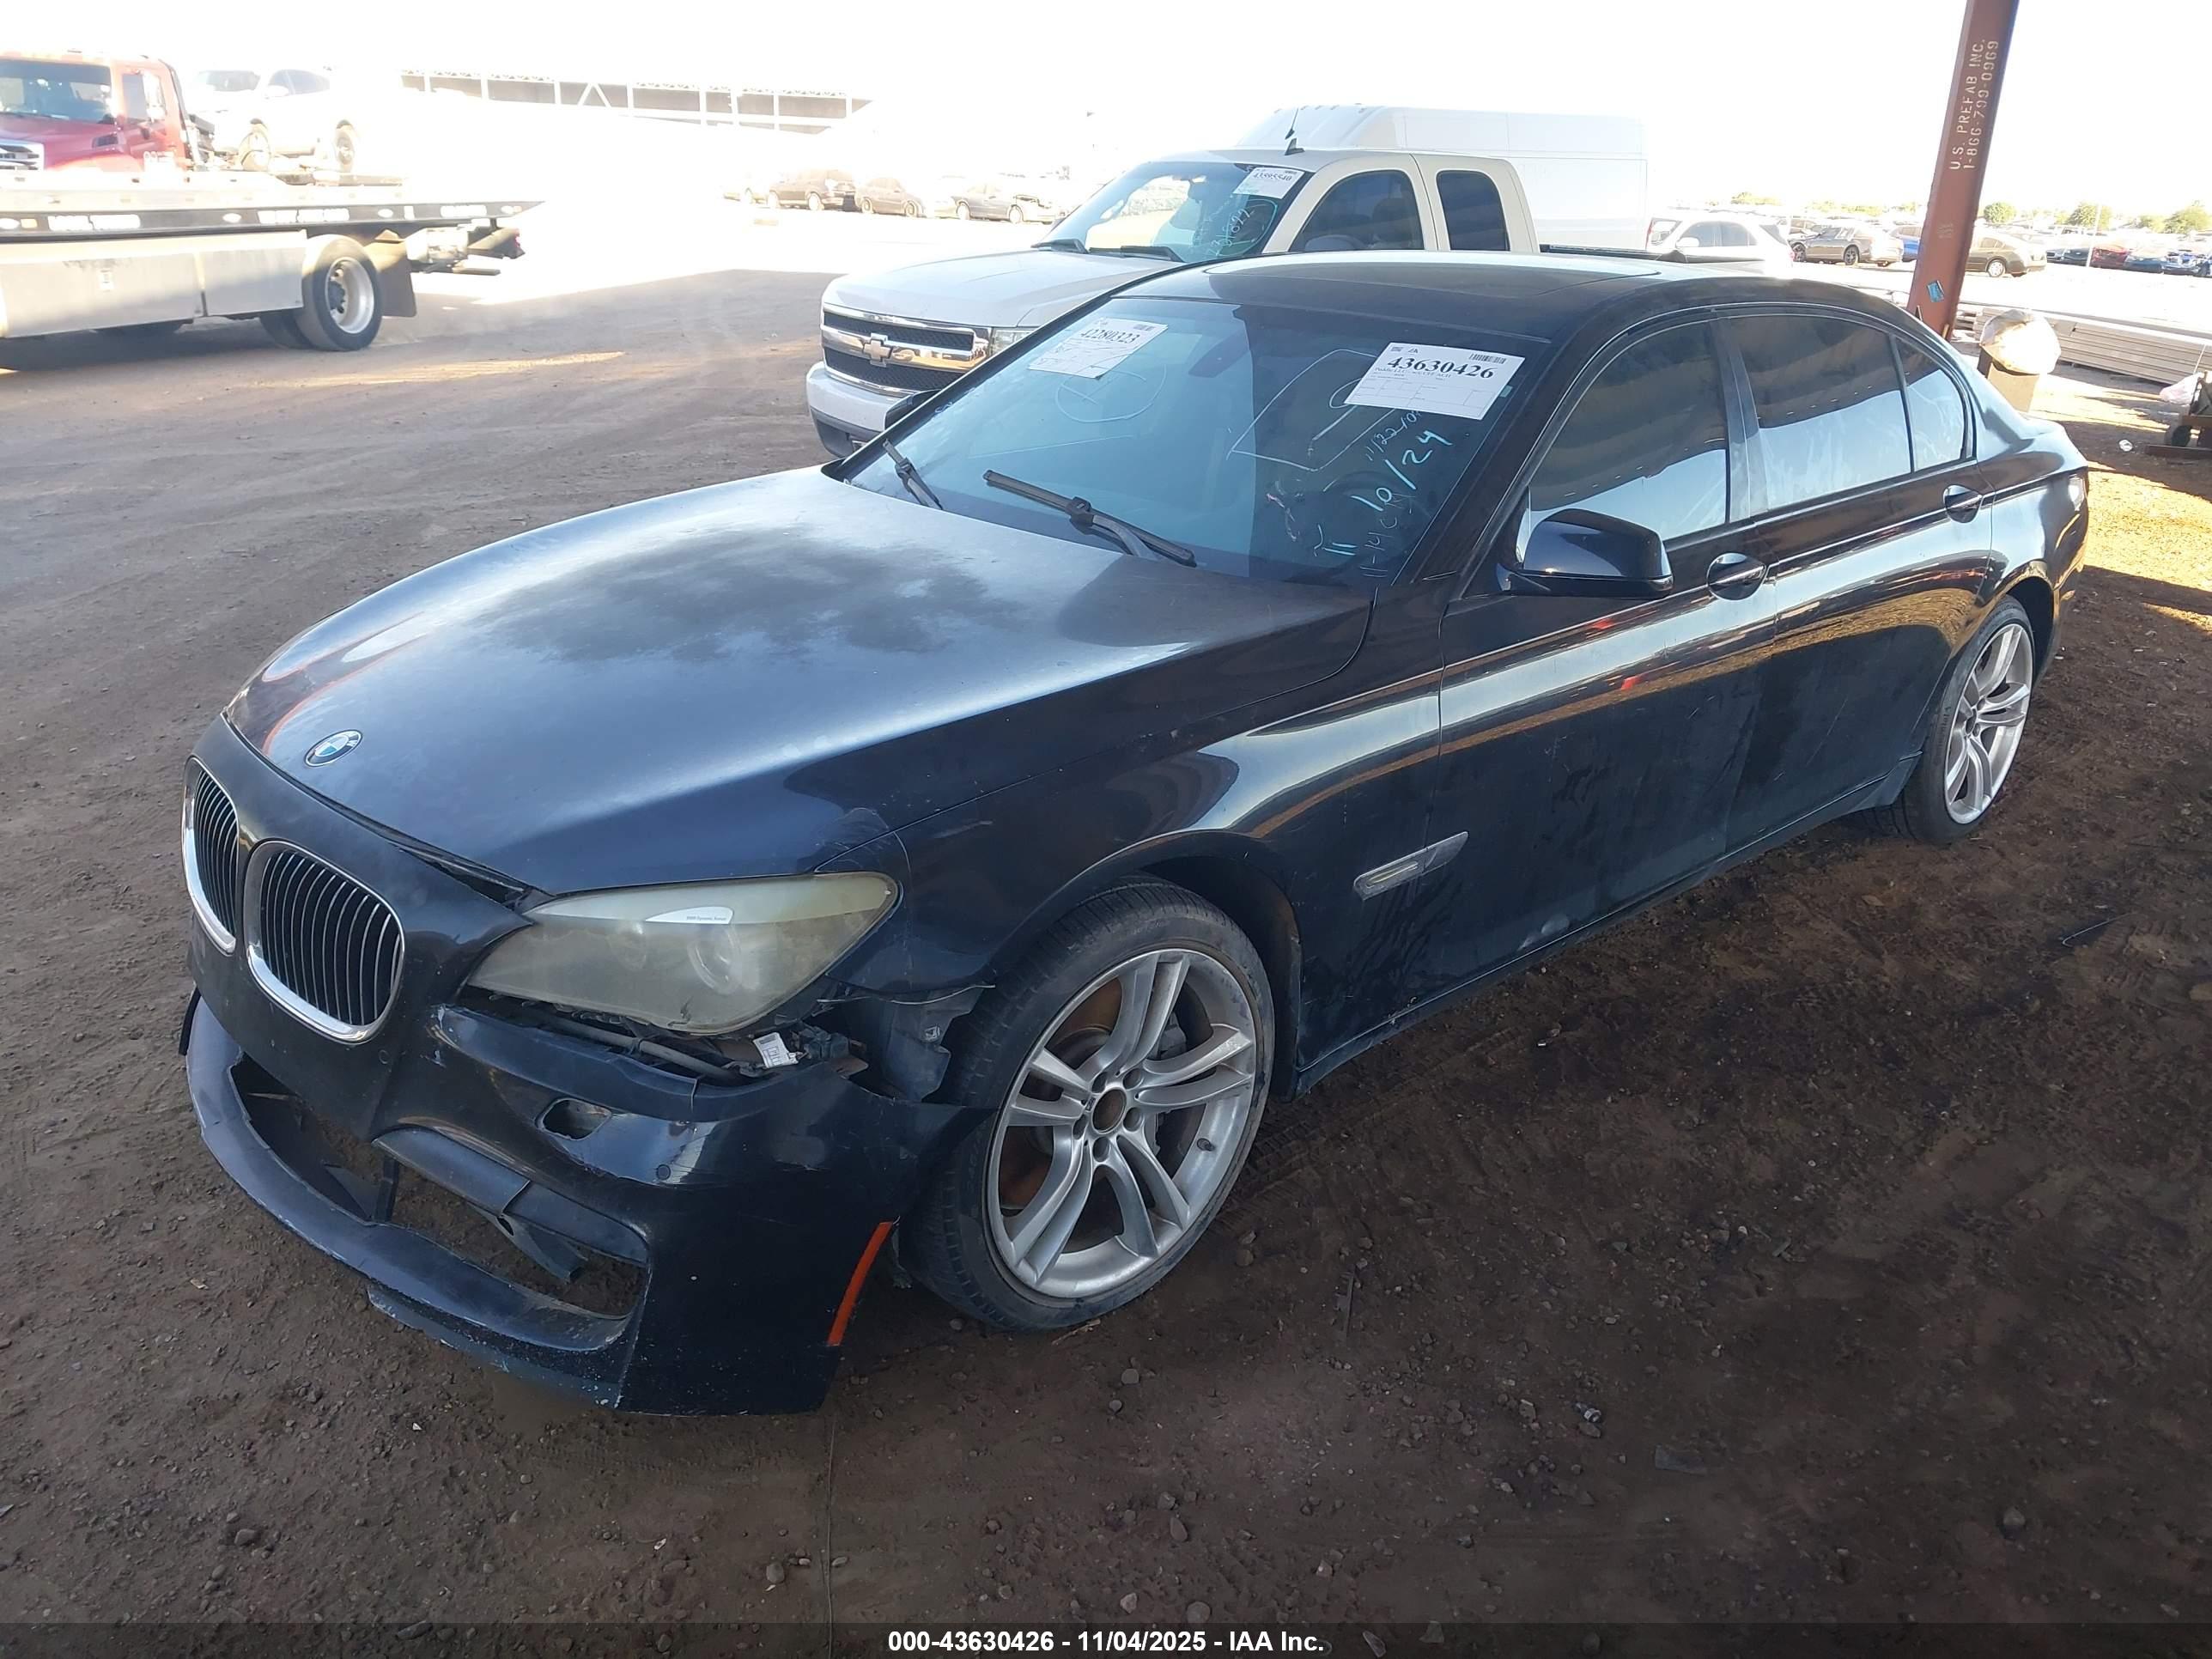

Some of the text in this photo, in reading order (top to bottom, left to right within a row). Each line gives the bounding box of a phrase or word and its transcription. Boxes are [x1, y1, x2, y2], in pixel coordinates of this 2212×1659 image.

[1949, 39, 1985, 170] U.S. PREFAB INC.
[1963, 40, 1999, 169] 1-866-799-0969
[1387, 356, 1498, 379] 43630426
